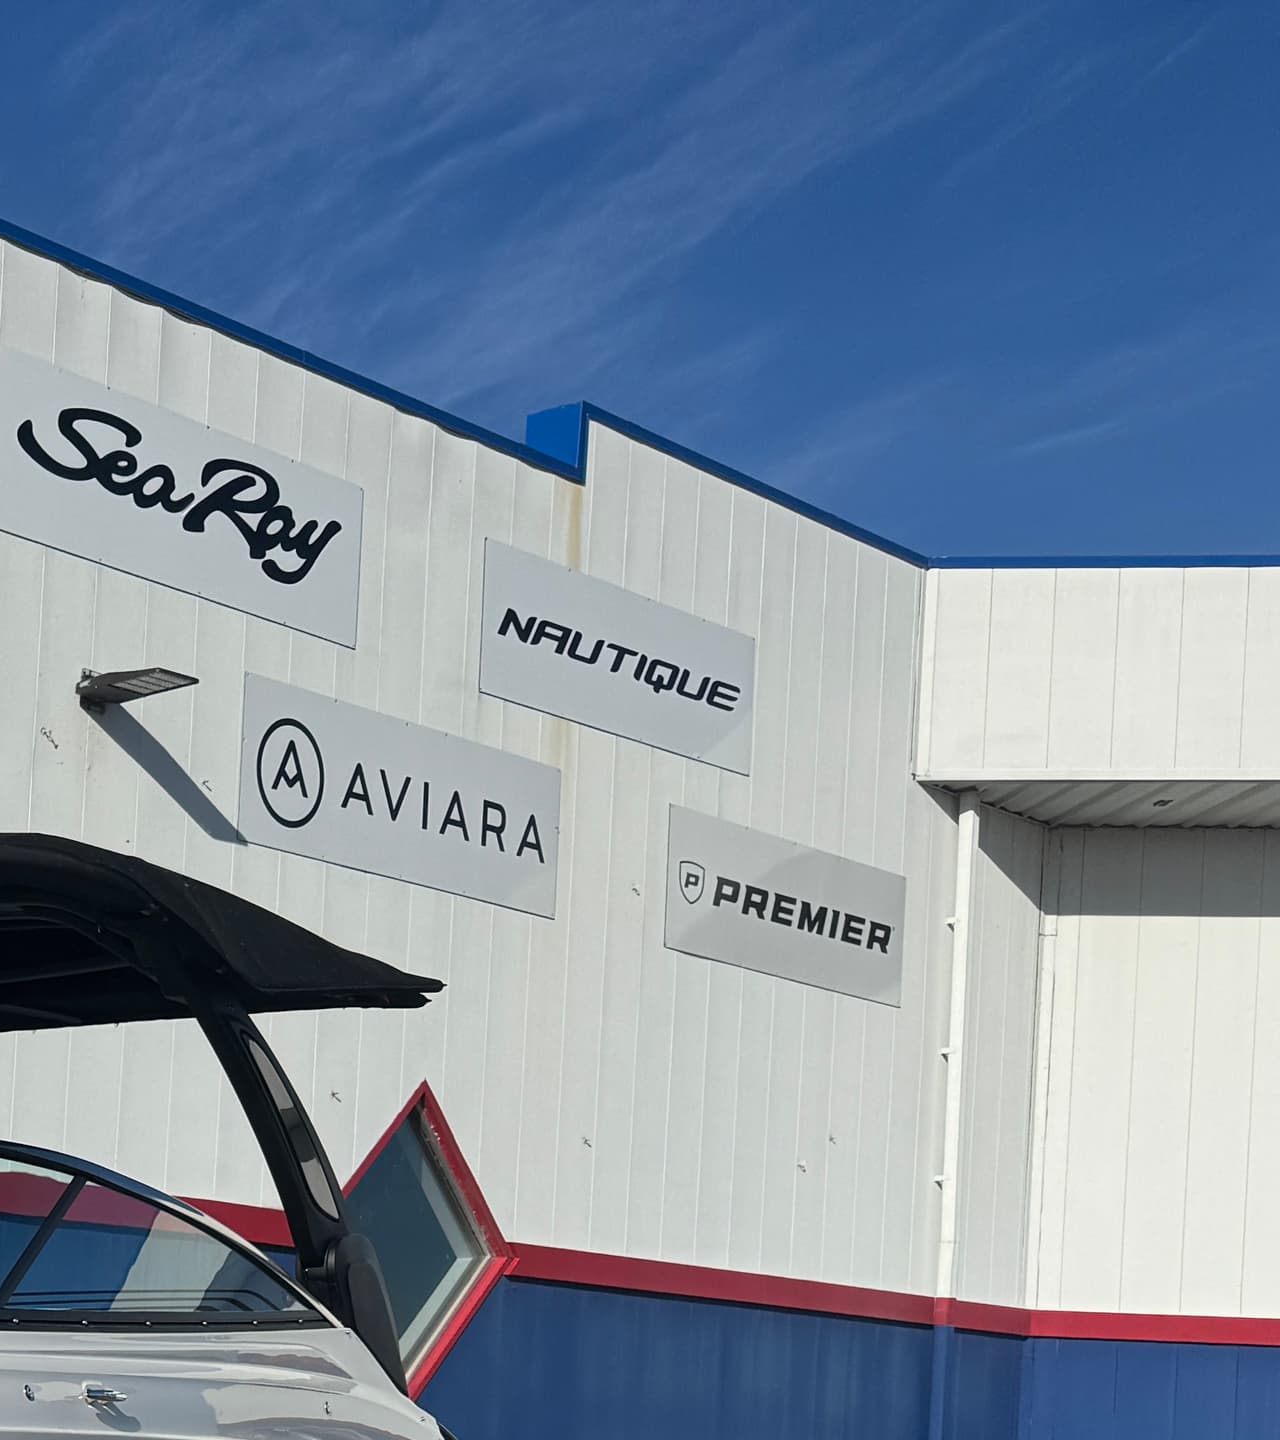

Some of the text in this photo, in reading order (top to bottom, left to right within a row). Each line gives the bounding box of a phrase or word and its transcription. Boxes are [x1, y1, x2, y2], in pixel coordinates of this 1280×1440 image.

[17, 407, 342, 585] Sea Ray
[497, 607, 741, 712] NAUTIQUE
[340, 762, 545, 864] AVIARA
[712, 876, 892, 954] PREMIER
